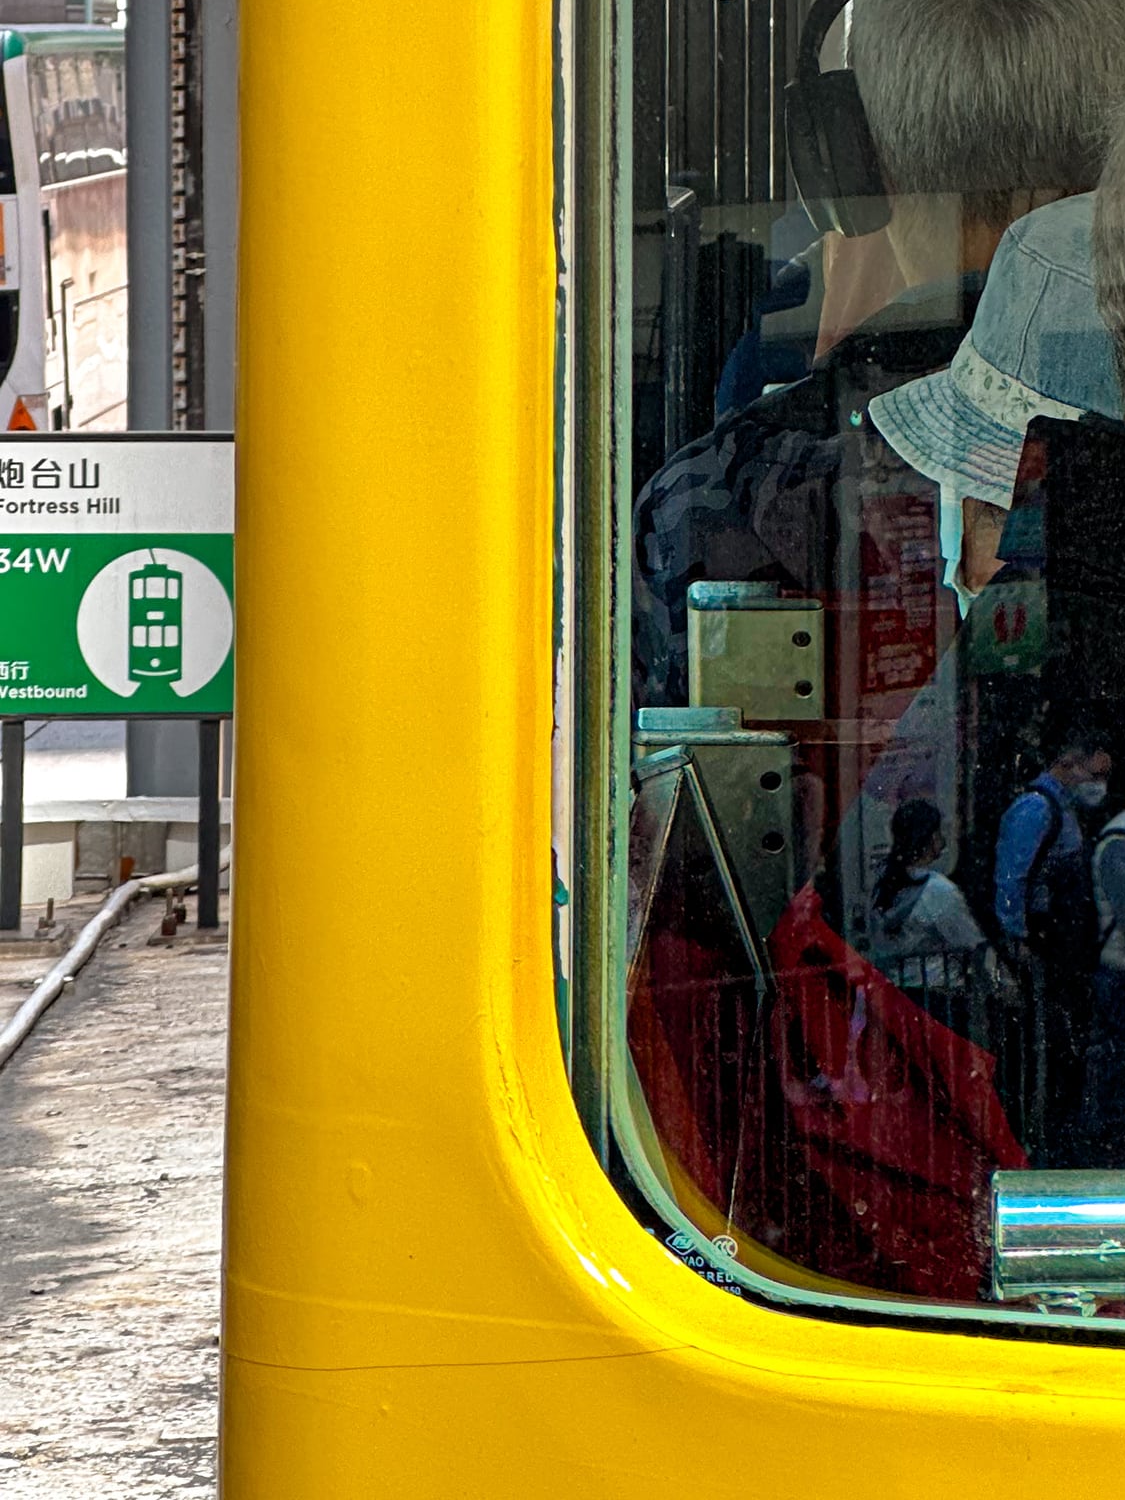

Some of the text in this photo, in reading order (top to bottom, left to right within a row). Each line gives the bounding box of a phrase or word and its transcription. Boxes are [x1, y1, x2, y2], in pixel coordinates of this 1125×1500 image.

[0, 458, 100, 489] 炮台山
[87, 498, 120, 514] Hill
[0, 547, 71, 573] 34W
